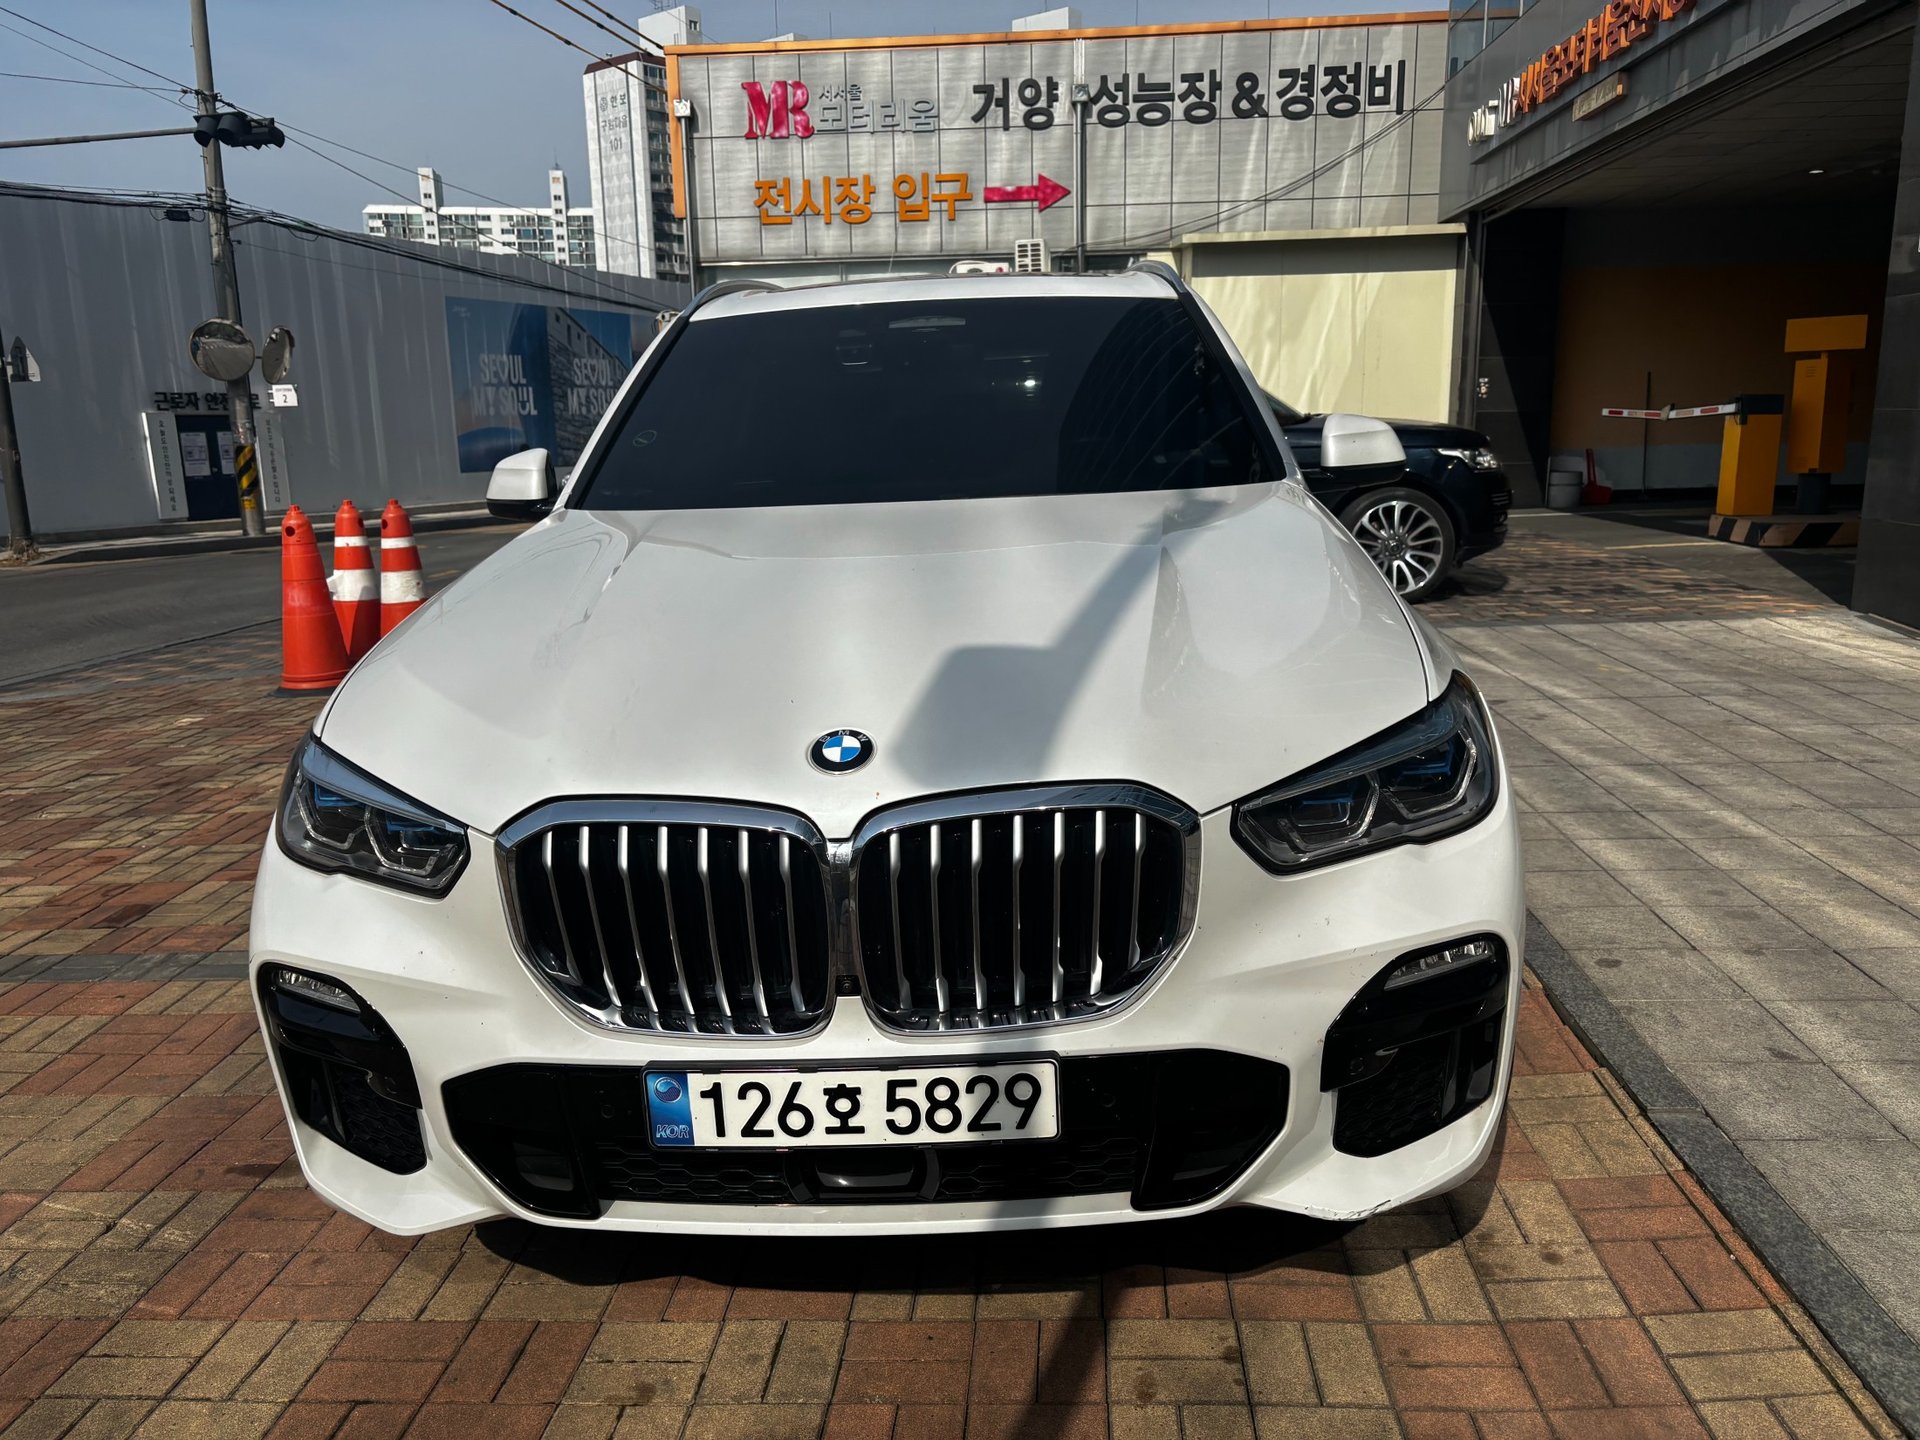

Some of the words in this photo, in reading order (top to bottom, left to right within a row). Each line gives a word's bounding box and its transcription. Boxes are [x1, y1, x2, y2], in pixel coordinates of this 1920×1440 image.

[819, 84, 862, 101] 서서울
[971, 76, 1059, 131] 거양
[741, 80, 815, 140] MR
[816, 98, 939, 134] 모터리움
[754, 174, 876, 225] 전시장
[893, 171, 973, 222] 입구
[480, 354, 527, 385] SEOUL
[154, 391, 200, 411] 근로자
[205, 392, 262, 411] 안전로
[282, 394, 288, 403] 2
[499, 387, 538, 416] SOUL
[819, 730, 869, 742] BMW
[885, 1072, 1042, 1136] 5829
[656, 1124, 690, 1139] KOR
